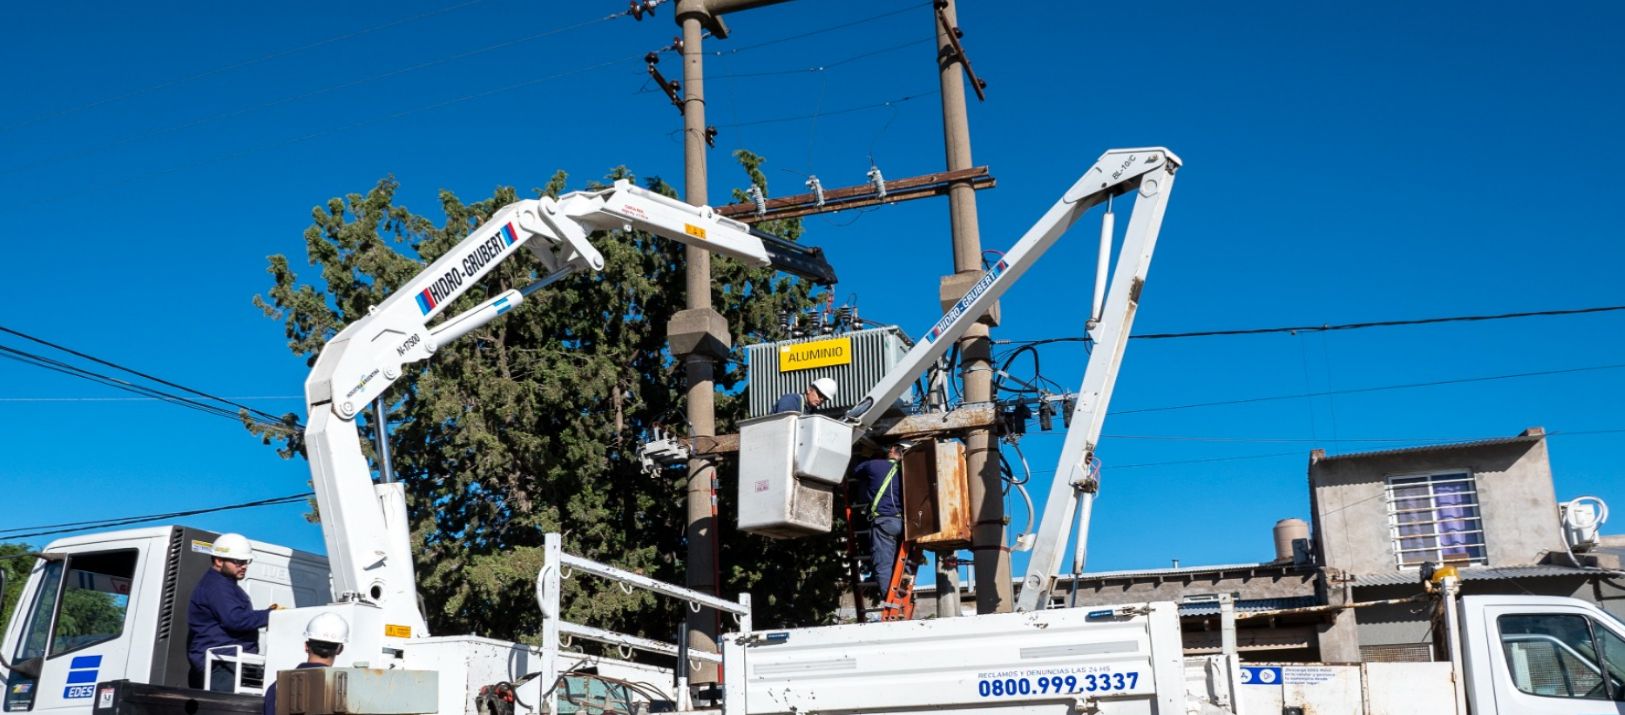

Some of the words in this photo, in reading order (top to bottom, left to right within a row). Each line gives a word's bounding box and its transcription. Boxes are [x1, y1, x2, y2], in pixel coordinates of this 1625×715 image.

[1112, 154, 1136, 180] BL-10/C
[428, 231, 506, 305] HIDRO-GRUBERT
[938, 271, 997, 332] HIDRO-GRUBERT
[788, 346, 844, 363] ALUMINIO
[978, 671, 1018, 679] RECLAMOS
[1027, 668, 1070, 676] DENUNCIAS
[978, 672, 1139, 697] 0800.999.3337
[68, 686, 94, 698] EDES
